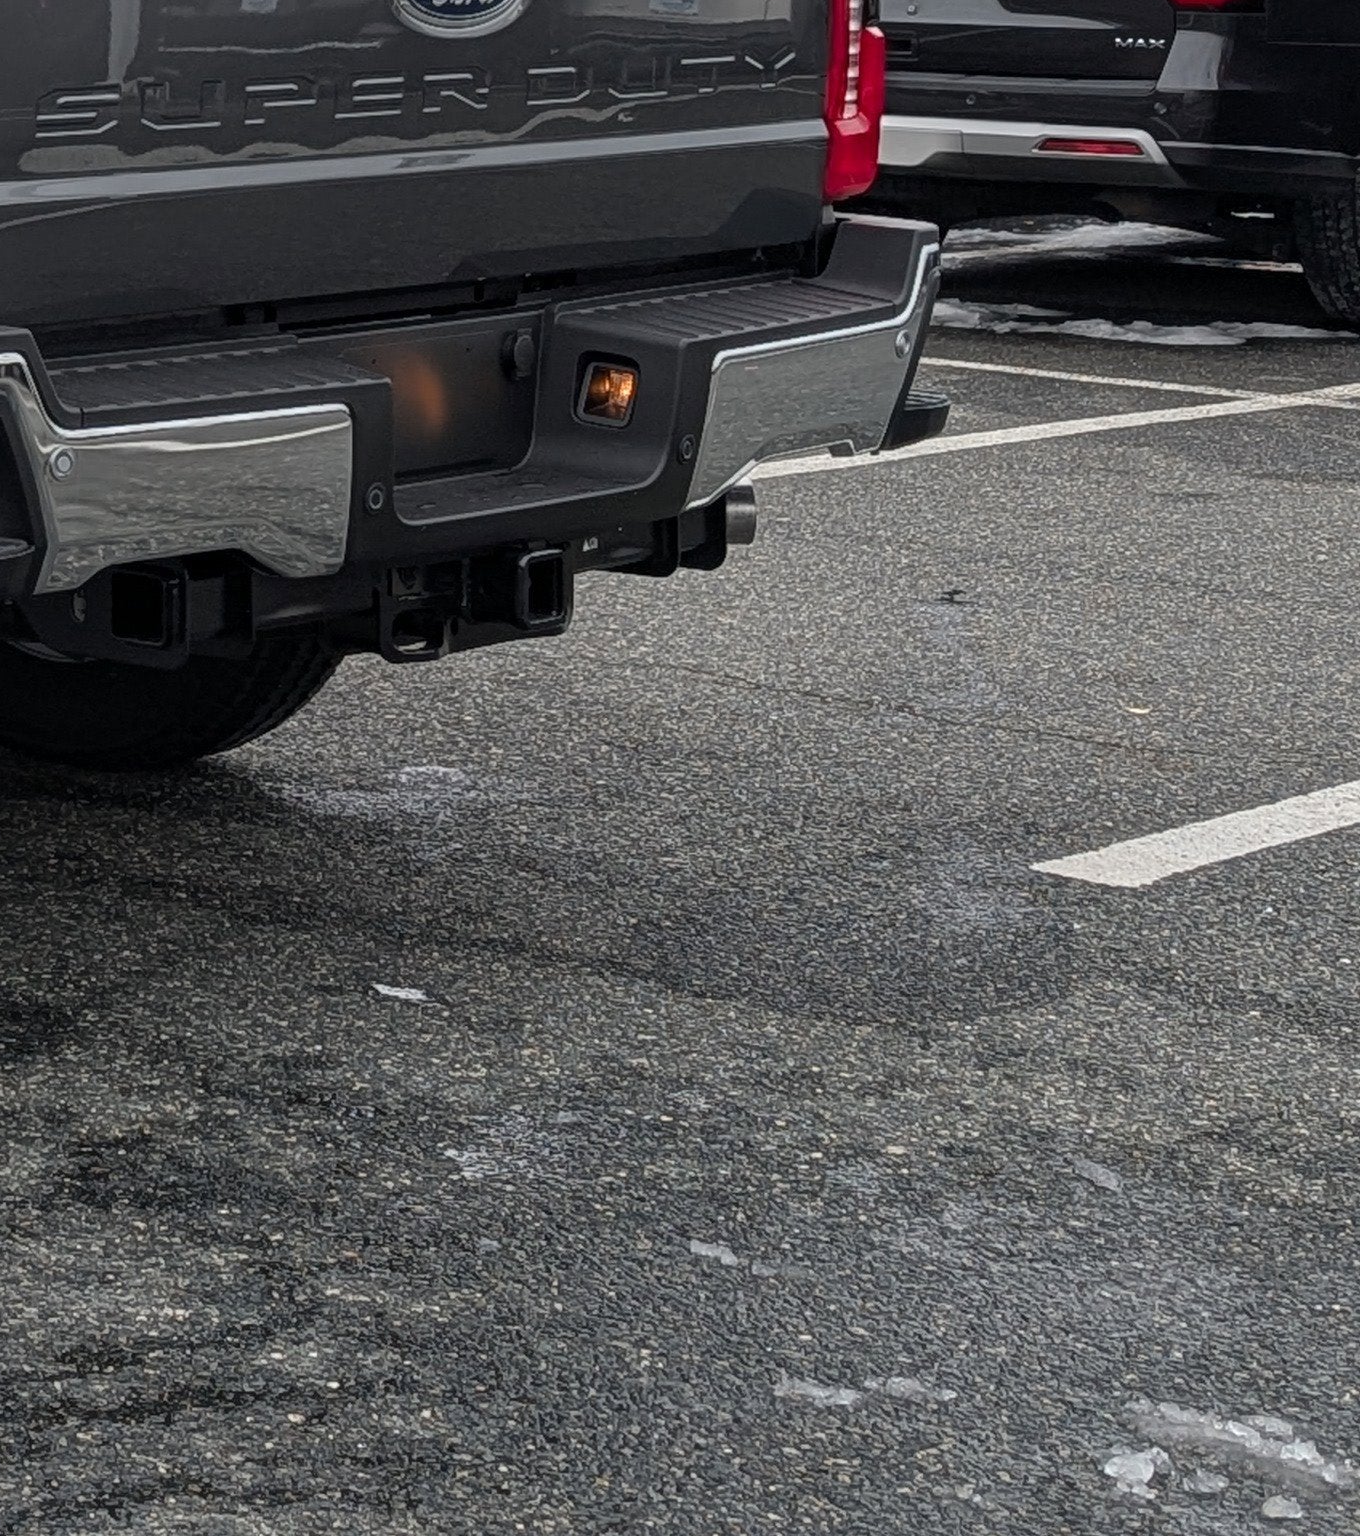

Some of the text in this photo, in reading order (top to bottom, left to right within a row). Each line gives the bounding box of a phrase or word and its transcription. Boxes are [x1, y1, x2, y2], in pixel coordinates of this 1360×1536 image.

[1114, 37, 1166, 50] MAX
[34, 47, 797, 138] SUPER DUTY
